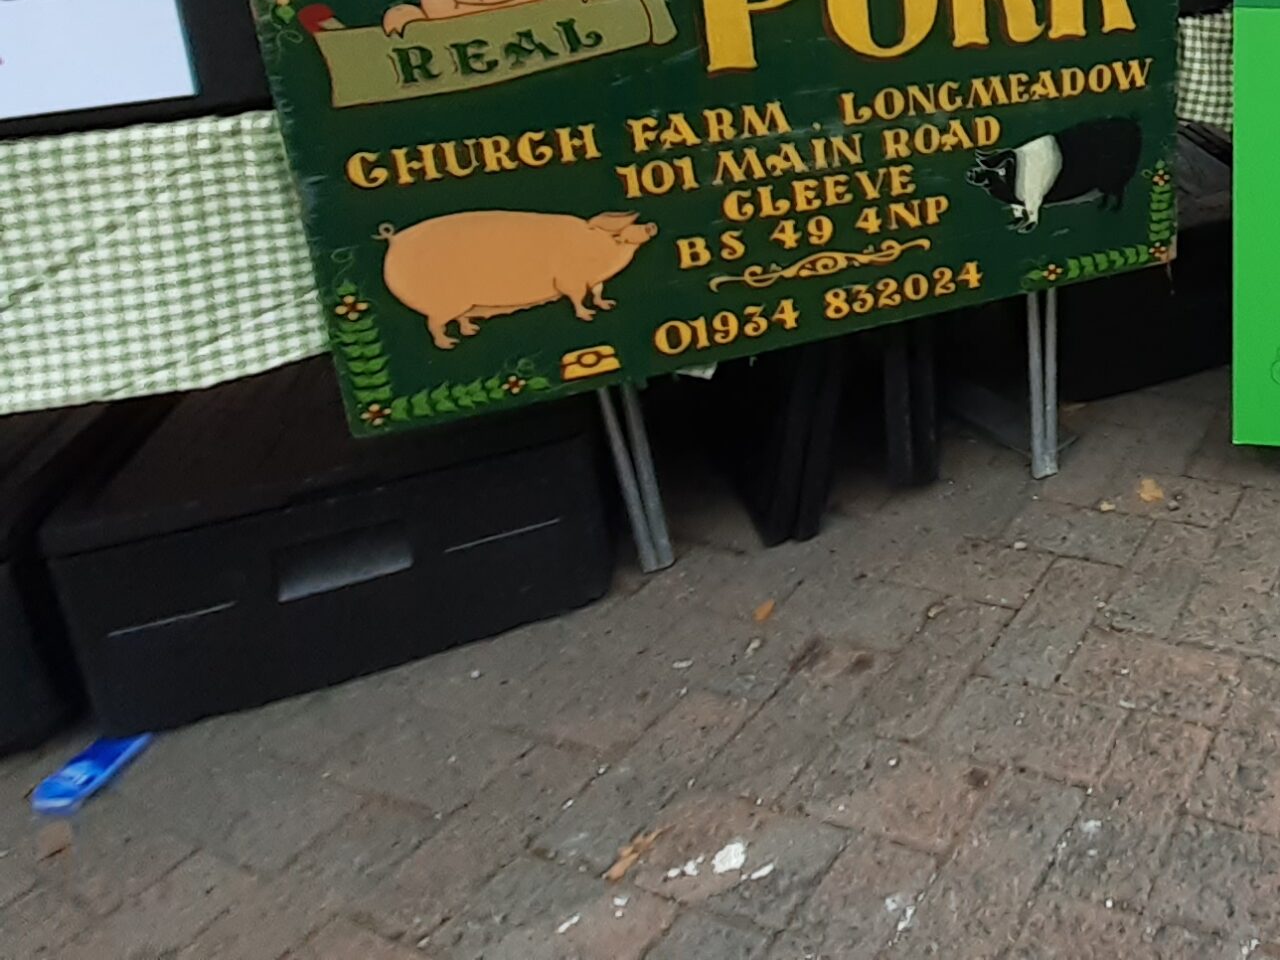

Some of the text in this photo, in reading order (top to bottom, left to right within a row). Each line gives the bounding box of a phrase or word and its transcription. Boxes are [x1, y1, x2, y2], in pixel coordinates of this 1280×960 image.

[389, 17, 603, 85] REAL
[345, 122, 602, 190] CHURCH
[626, 100, 792, 154] FARM
[615, 115, 1002, 200] 101 MAIN ROAD
[722, 164, 917, 223] CLEEVE
[855, 195, 951, 236] 4NP
[652, 260, 985, 357] 01934 832024
